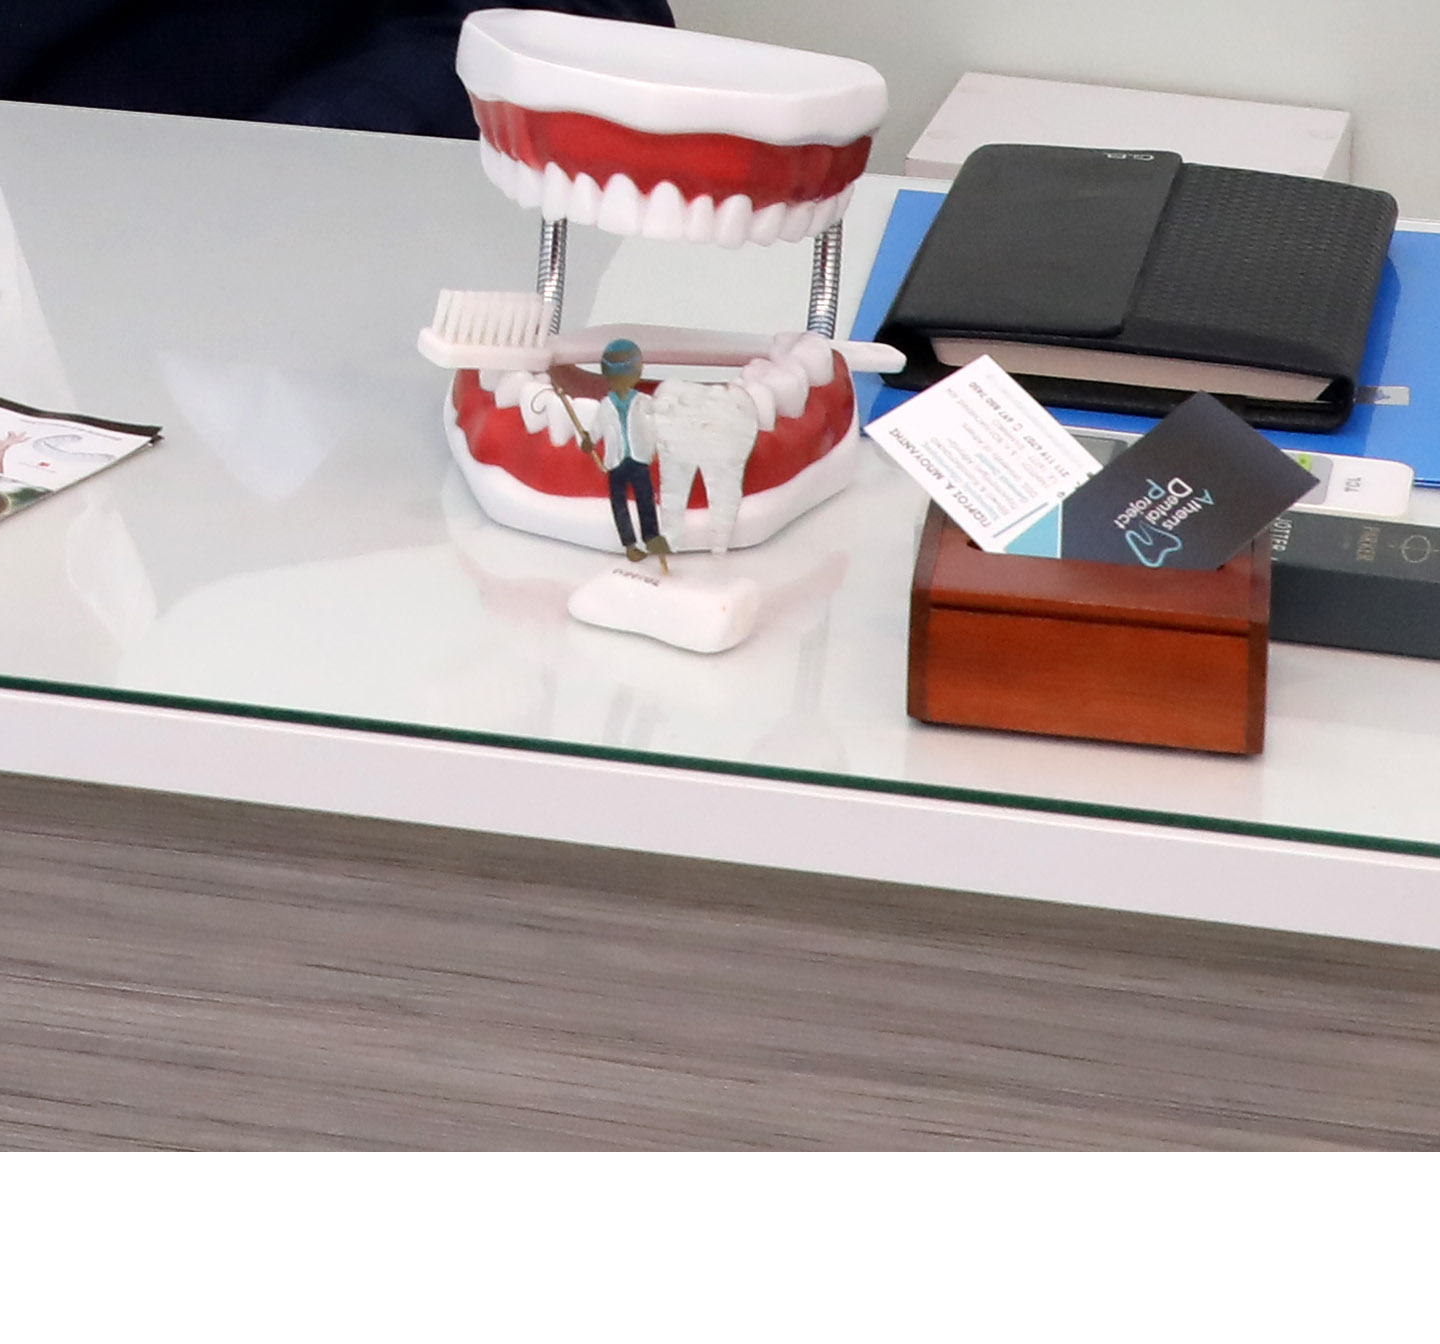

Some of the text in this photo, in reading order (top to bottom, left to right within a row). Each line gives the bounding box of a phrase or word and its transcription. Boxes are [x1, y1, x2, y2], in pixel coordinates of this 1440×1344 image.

[1114, 479, 1166, 530] Project
[1145, 477, 1193, 525] Dental
[1162, 489, 1215, 531] Athens
